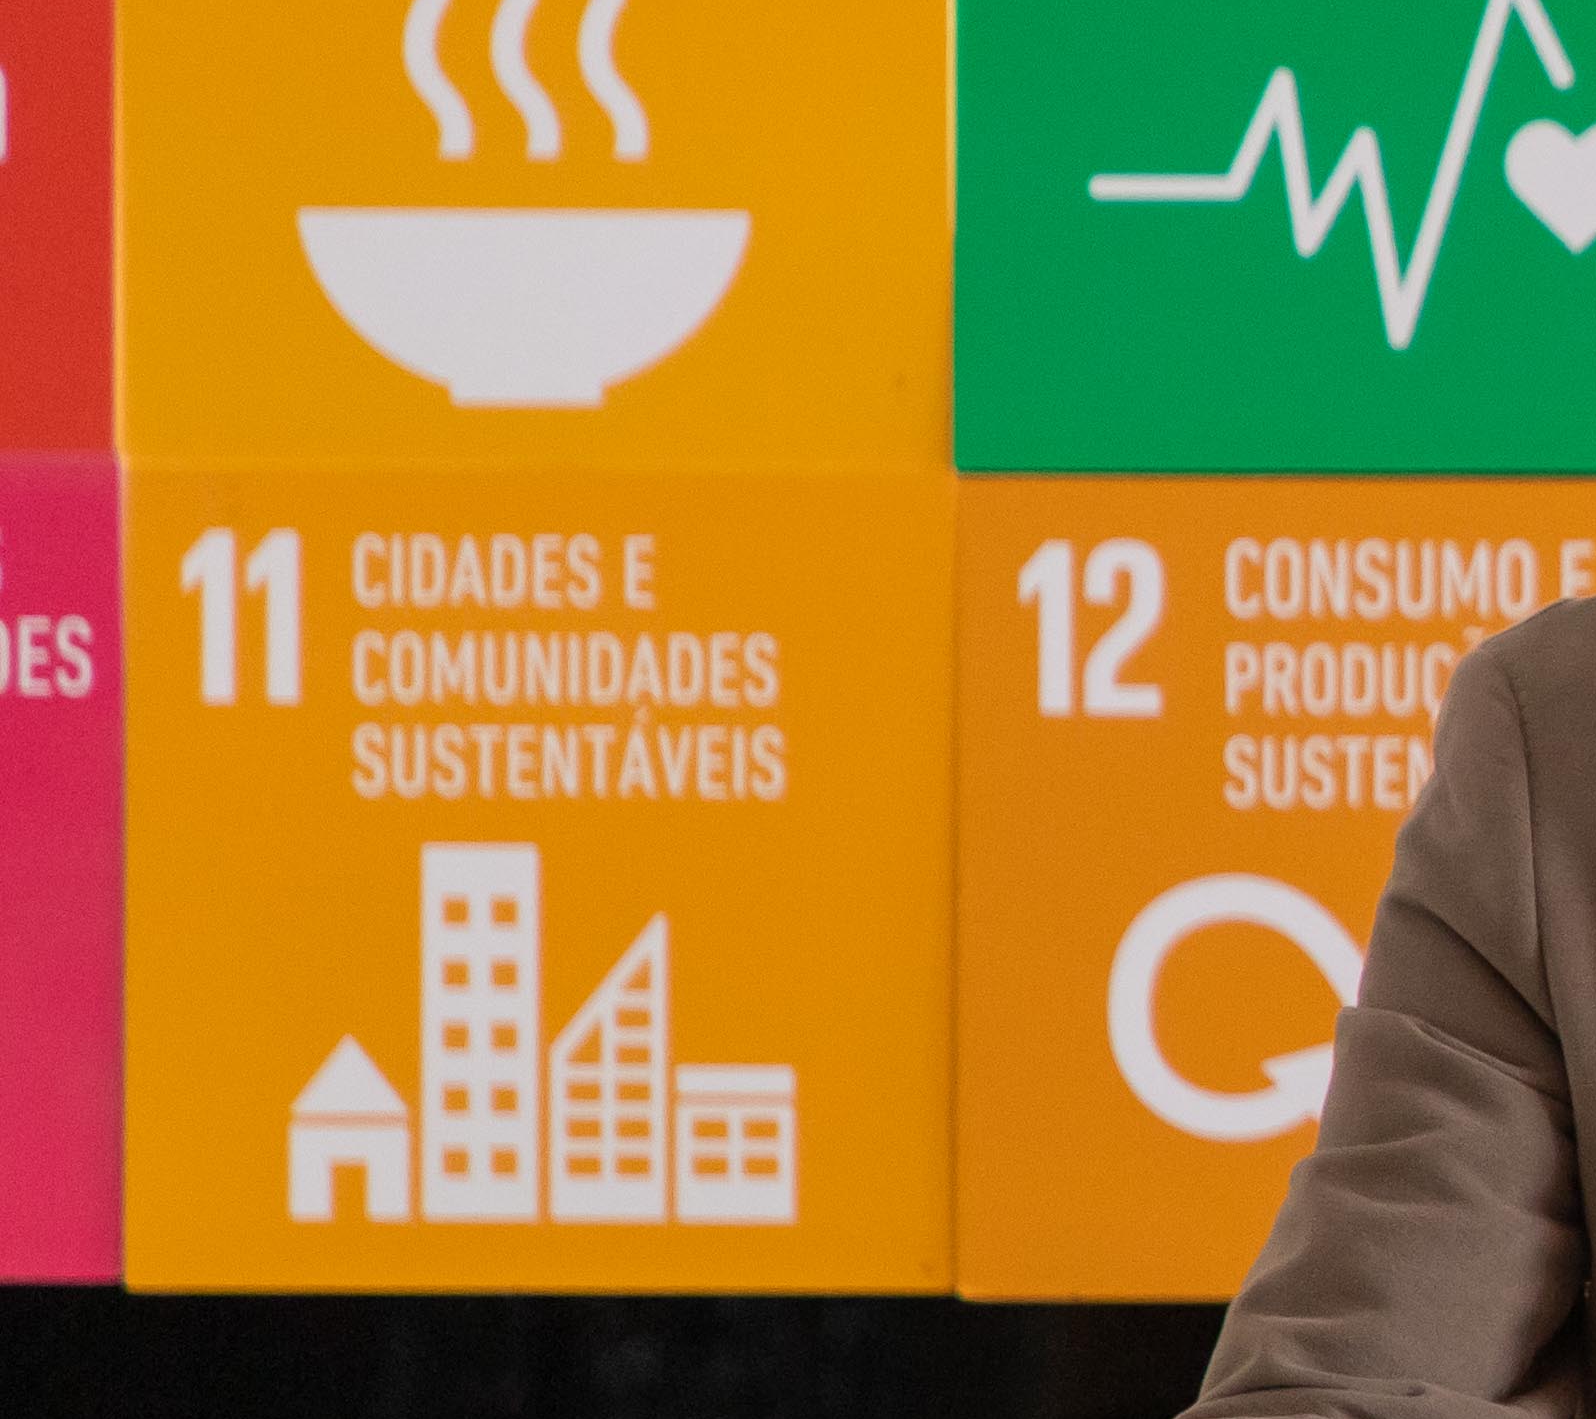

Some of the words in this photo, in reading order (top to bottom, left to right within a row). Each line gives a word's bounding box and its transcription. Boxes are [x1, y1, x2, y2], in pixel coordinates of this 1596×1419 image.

[352, 532, 603, 610] CIDADES
[623, 535, 654, 609] E
[1223, 536, 1540, 621] CONSUMO
[1559, 538, 1596, 600] E
[181, 528, 302, 706] 11
[1018, 538, 1166, 718] 12
[352, 630, 779, 712] COMUNIDADES
[1223, 625, 1486, 718] PRODUÇ
[350, 710, 787, 801] SUSTENTÁVEIS
